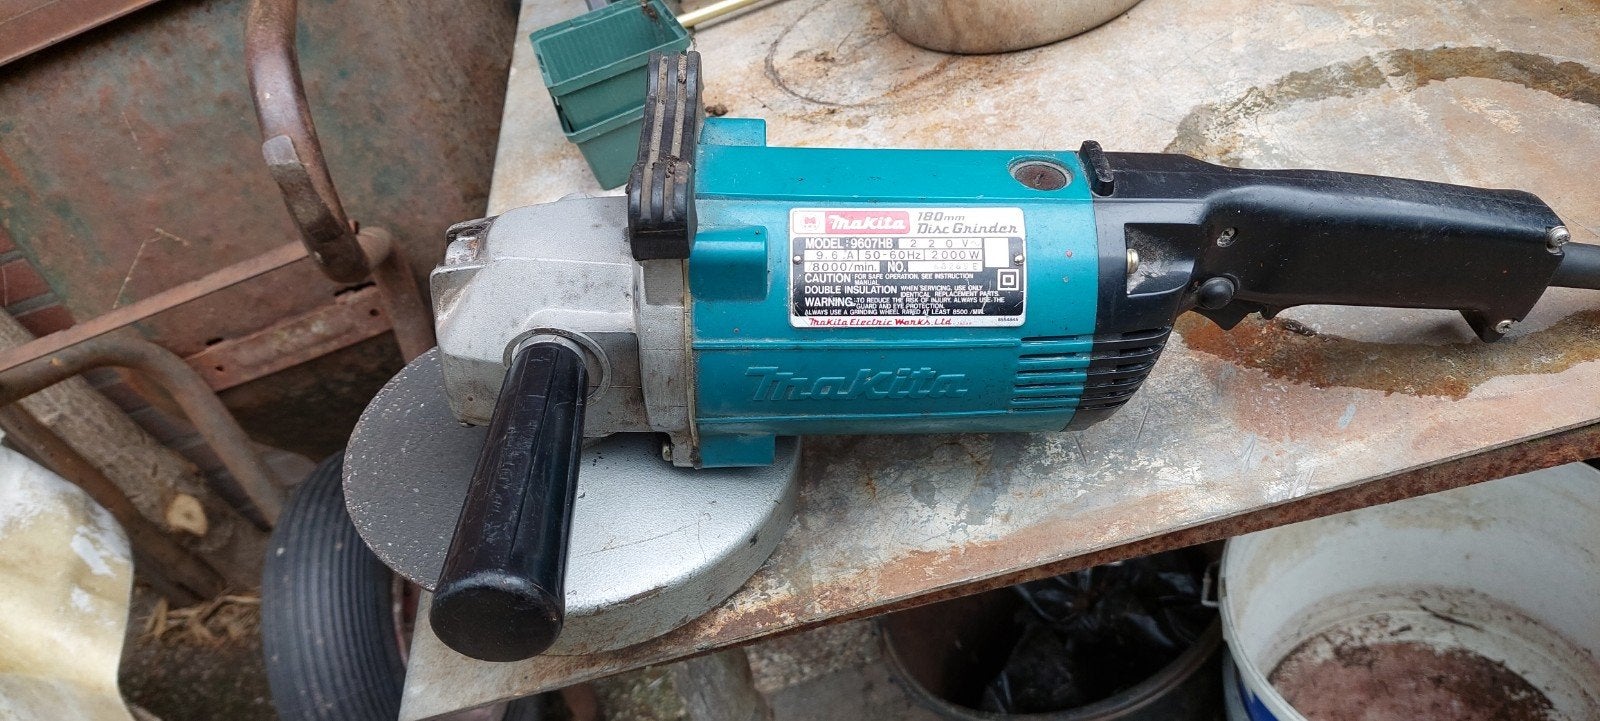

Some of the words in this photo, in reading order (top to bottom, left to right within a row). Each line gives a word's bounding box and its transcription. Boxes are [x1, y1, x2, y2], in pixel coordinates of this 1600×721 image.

[918, 212, 965, 221] 180mm
[828, 214, 907, 230] Makita
[917, 223, 949, 234] Disc
[952, 222, 1018, 233] Grinder
[850, 238, 893, 249] 9607HB
[864, 251, 921, 260] 50-60Hz
[812, 263, 877, 272] 8000/min.
[887, 262, 908, 273] NO.
[804, 285, 842, 294] DOUBLE
[844, 285, 898, 294] INSULATION
[922, 308, 931, 316] AT
[809, 318, 848, 326] Makita
[849, 318, 893, 326] Electric
[745, 366, 968, 401] Makita
